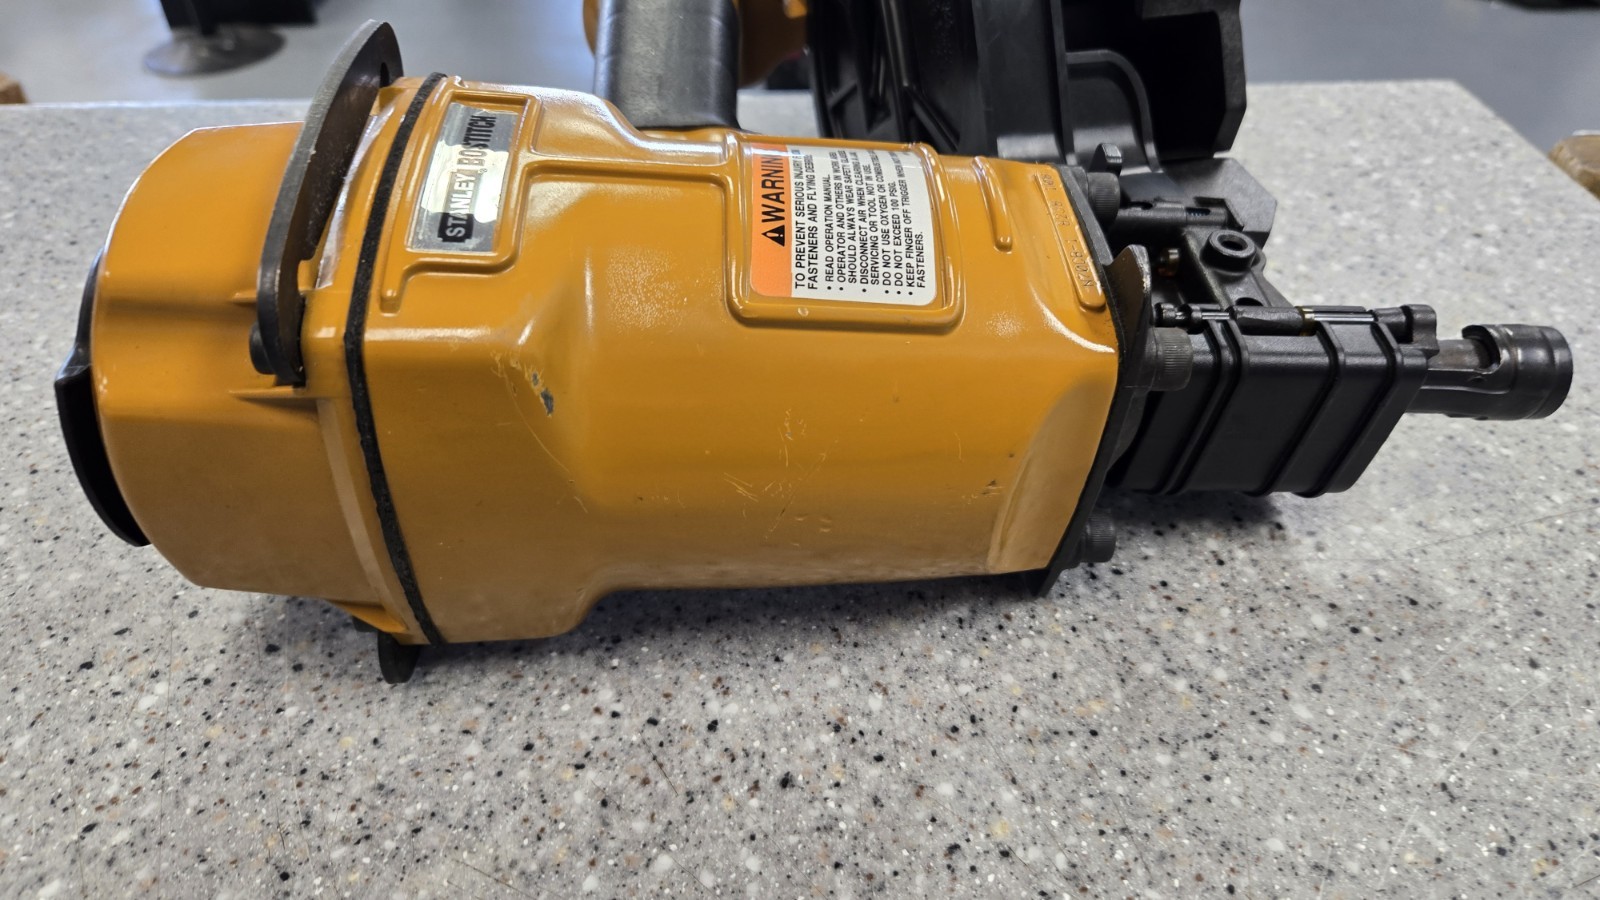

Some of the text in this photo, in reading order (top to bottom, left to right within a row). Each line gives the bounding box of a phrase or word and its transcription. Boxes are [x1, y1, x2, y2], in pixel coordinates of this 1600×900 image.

[445, 115, 497, 238] STANLEY BOSTITCH
[761, 150, 785, 223] WARNIN
[841, 164, 853, 184] SAFETY
[794, 181, 806, 218] SERIOUS
[805, 175, 817, 201] FLYING
[833, 182, 845, 210] OTHERS
[844, 183, 855, 205] WEAR
[855, 187, 866, 207] WHEN
[865, 181, 876, 196] NOT
[876, 183, 887, 194] OR
[898, 179, 911, 207] TRIGGER
[806, 203, 818, 223] AND
[857, 209, 868, 223] AIR
[867, 198, 877, 218] TOOL
[878, 195, 890, 226] OXYGEN
[890, 198, 900, 211] 100
[902, 208, 913, 225] OFF
[822, 174, 835, 283] READ OPERATION MANUAL.
[835, 212, 846, 230] AND
[846, 207, 857, 242] ALWAYS
[868, 220, 879, 233] OR
[891, 213, 902, 247] EXCEED
[795, 221, 806, 269] PREVENT
[880, 228, 891, 246] USE
[903, 227, 914, 259] FINGER
[807, 226, 819, 290] FASTENERS
[836, 231, 847, 283] OPERATOR
[847, 244, 858, 284] SHOULD
[858, 225, 869, 285] DISCONNECT
[869, 235, 880, 286] SERVICING
[881, 248, 891, 268] NOT
[893, 249, 903, 269] NOT
[914, 231, 926, 289] FASTENERS.
[795, 272, 806, 290] TO
[882, 271, 892, 286] DO
[893, 272, 904, 287] DO
[905, 262, 916, 288] KEEP
